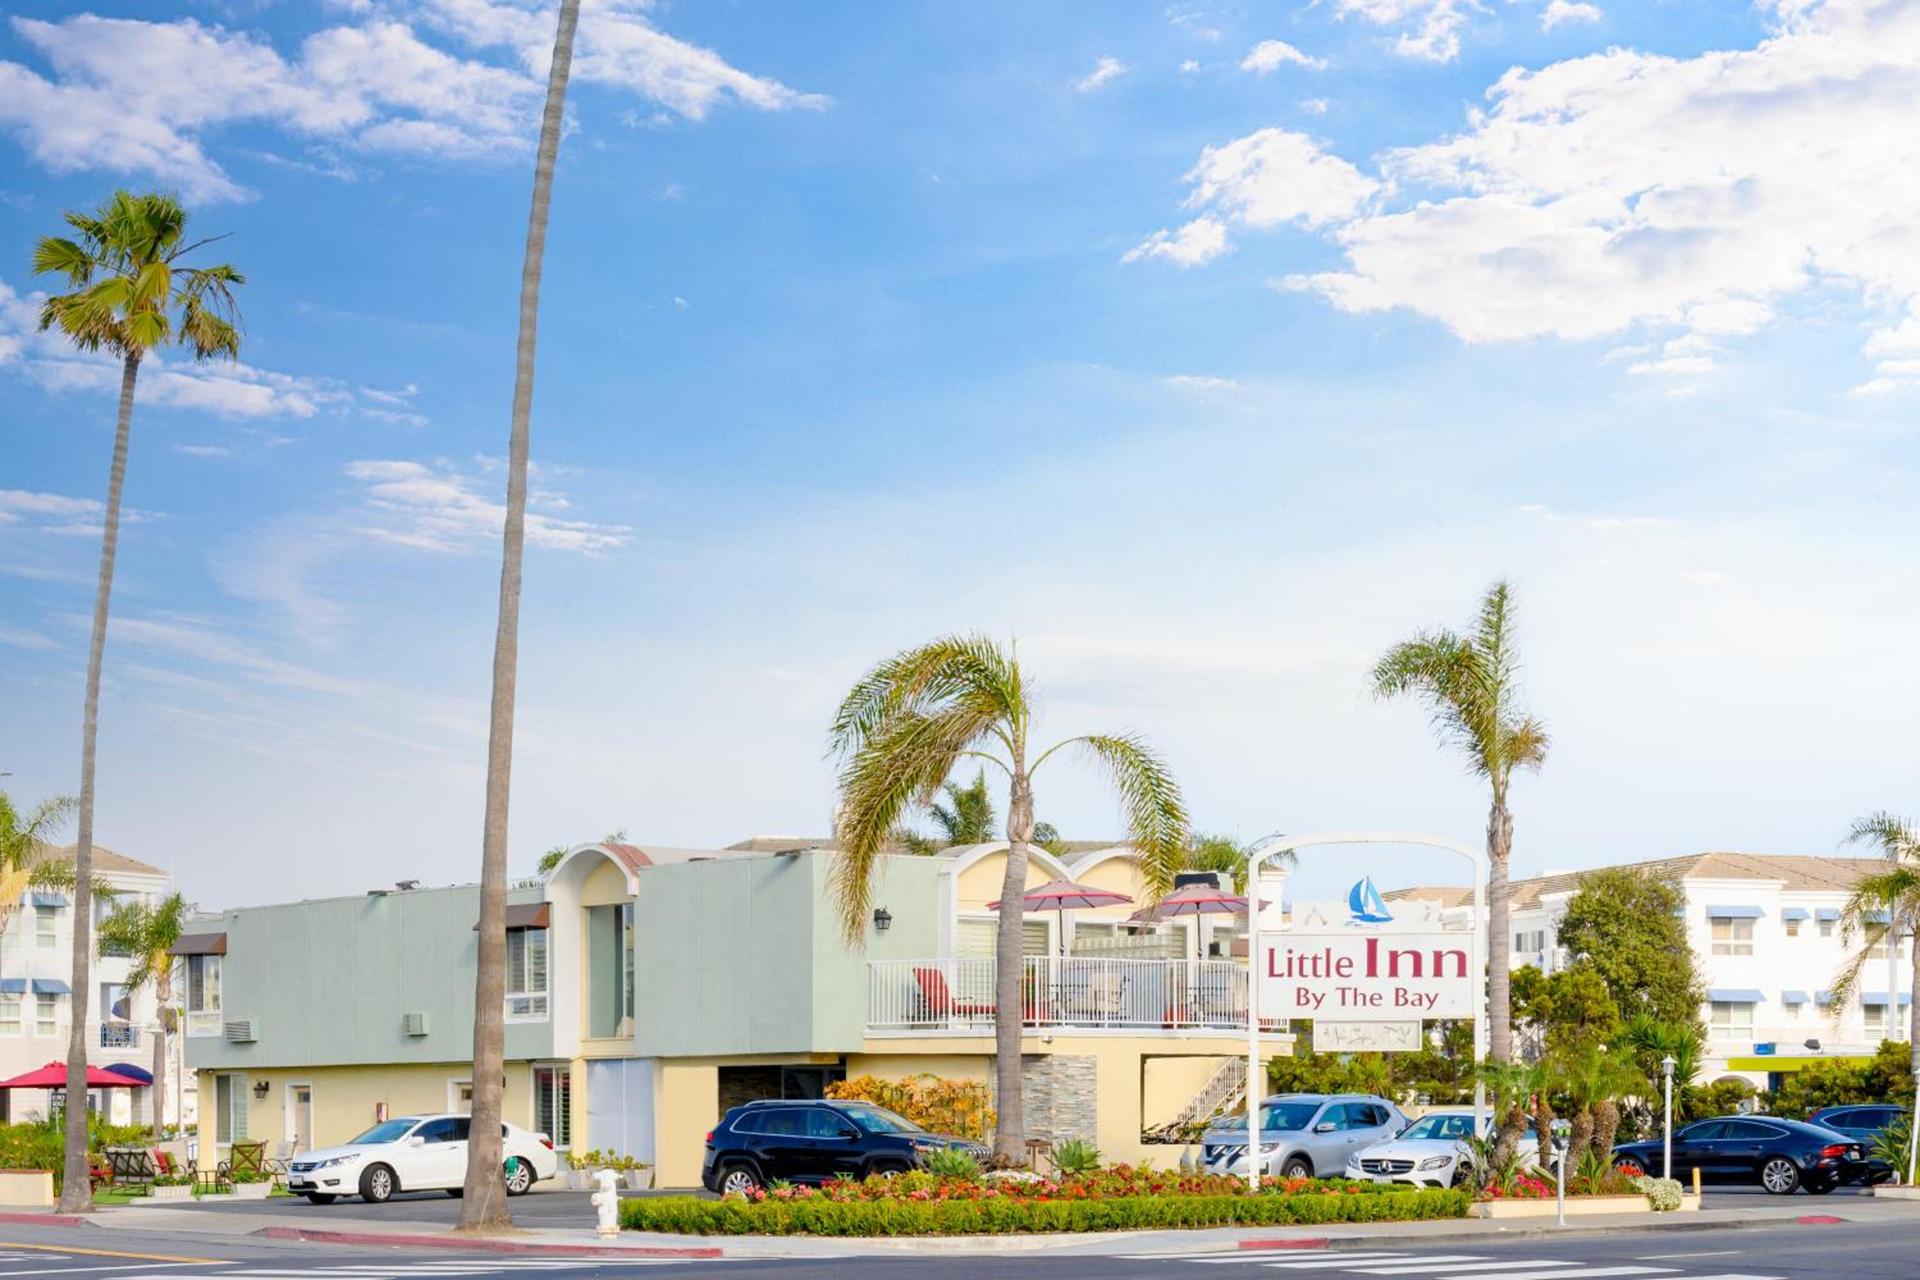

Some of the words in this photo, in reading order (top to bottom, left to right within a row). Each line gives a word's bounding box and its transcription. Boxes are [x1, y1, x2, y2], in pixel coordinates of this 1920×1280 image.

[1268, 947, 1354, 978] Little
[1365, 938, 1468, 978] Inn
[1296, 987, 1326, 1010] By
[1335, 987, 1383, 1007] The
[1394, 987, 1439, 1010] Bay
